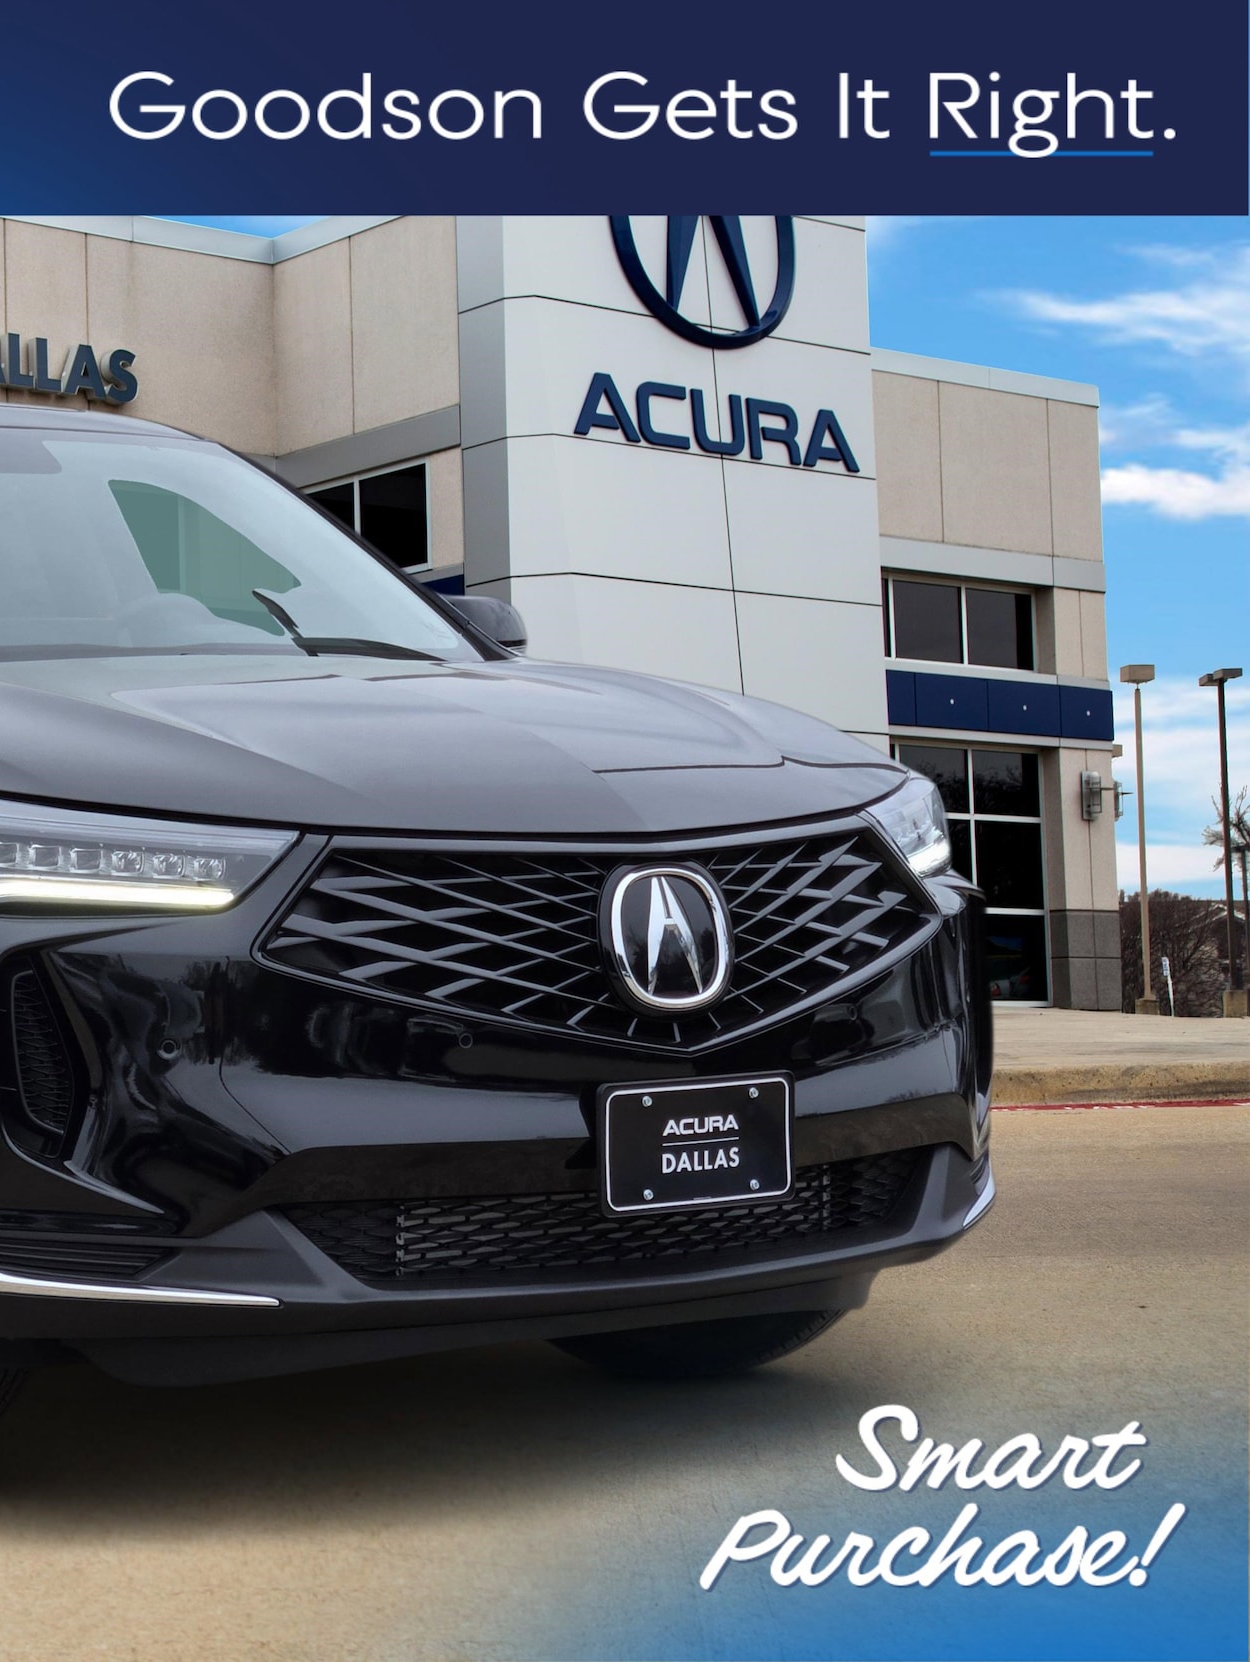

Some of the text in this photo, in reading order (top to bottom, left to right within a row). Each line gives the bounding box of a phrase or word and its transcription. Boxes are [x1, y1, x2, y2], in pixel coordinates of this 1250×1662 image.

[573, 372, 860, 473] ACURA
[662, 1114, 739, 1136] ACURA
[661, 1147, 740, 1174] DALLAS
